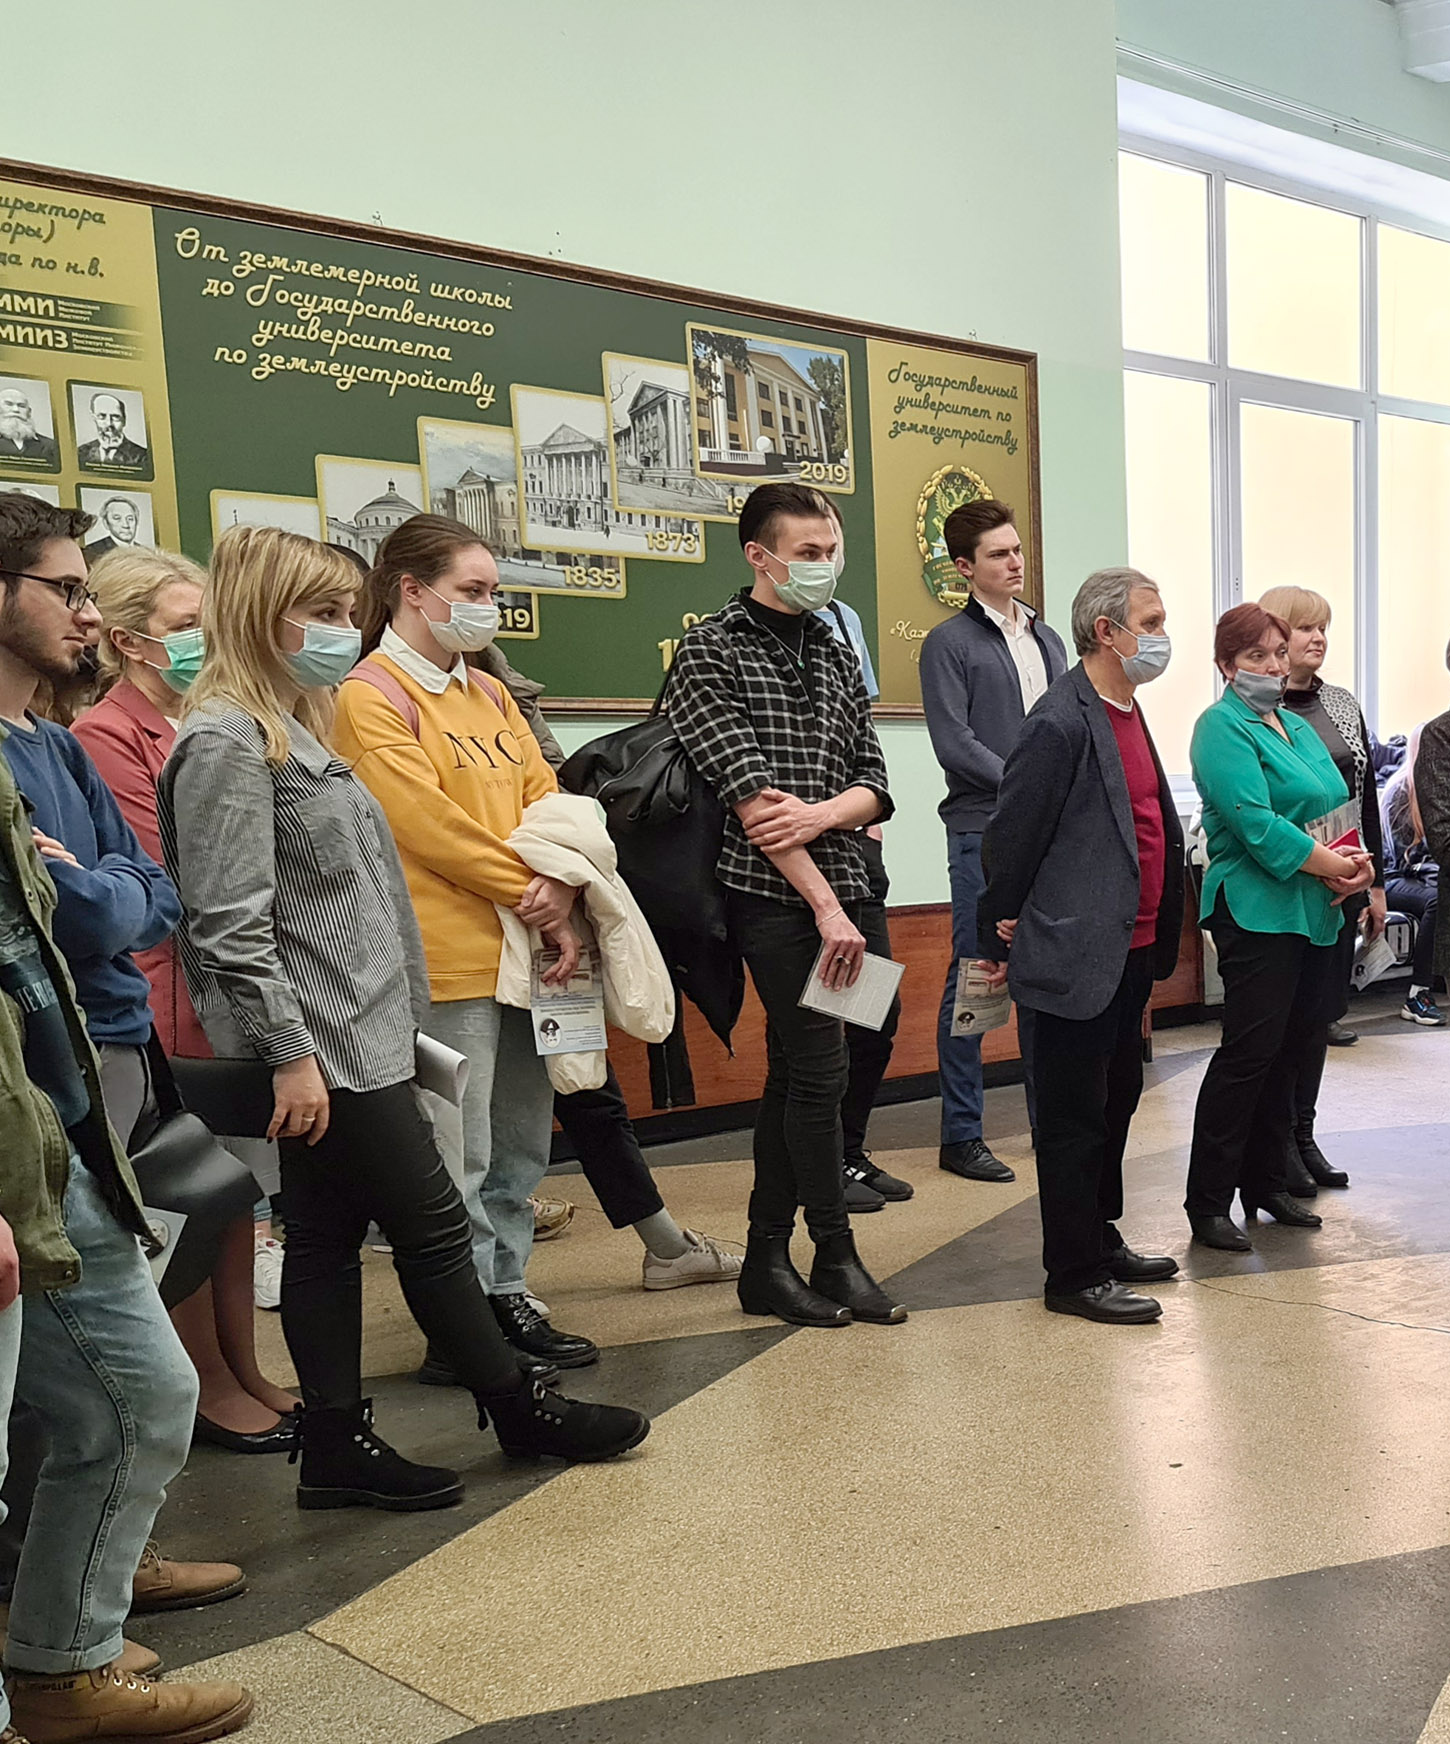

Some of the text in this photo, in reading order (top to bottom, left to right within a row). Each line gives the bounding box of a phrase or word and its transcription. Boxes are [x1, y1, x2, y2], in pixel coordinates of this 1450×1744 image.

[0, 196, 106, 230] иректора
[31, 256, 57, 270] по
[175, 227, 513, 310] От землемерной школы
[202, 274, 495, 337] до Государственного
[252, 316, 453, 361] университета
[214, 347, 496, 409] по землеустройству
[887, 361, 1018, 400] Государственный
[894, 392, 1012, 422] университет по
[888, 420, 1018, 455] землеустройству
[799, 460, 847, 483] 2019
[725, 494, 746, 515] 19
[645, 531, 697, 553] 1873
[563, 566, 619, 588] 1835
[442, 730, 524, 769] NYC
